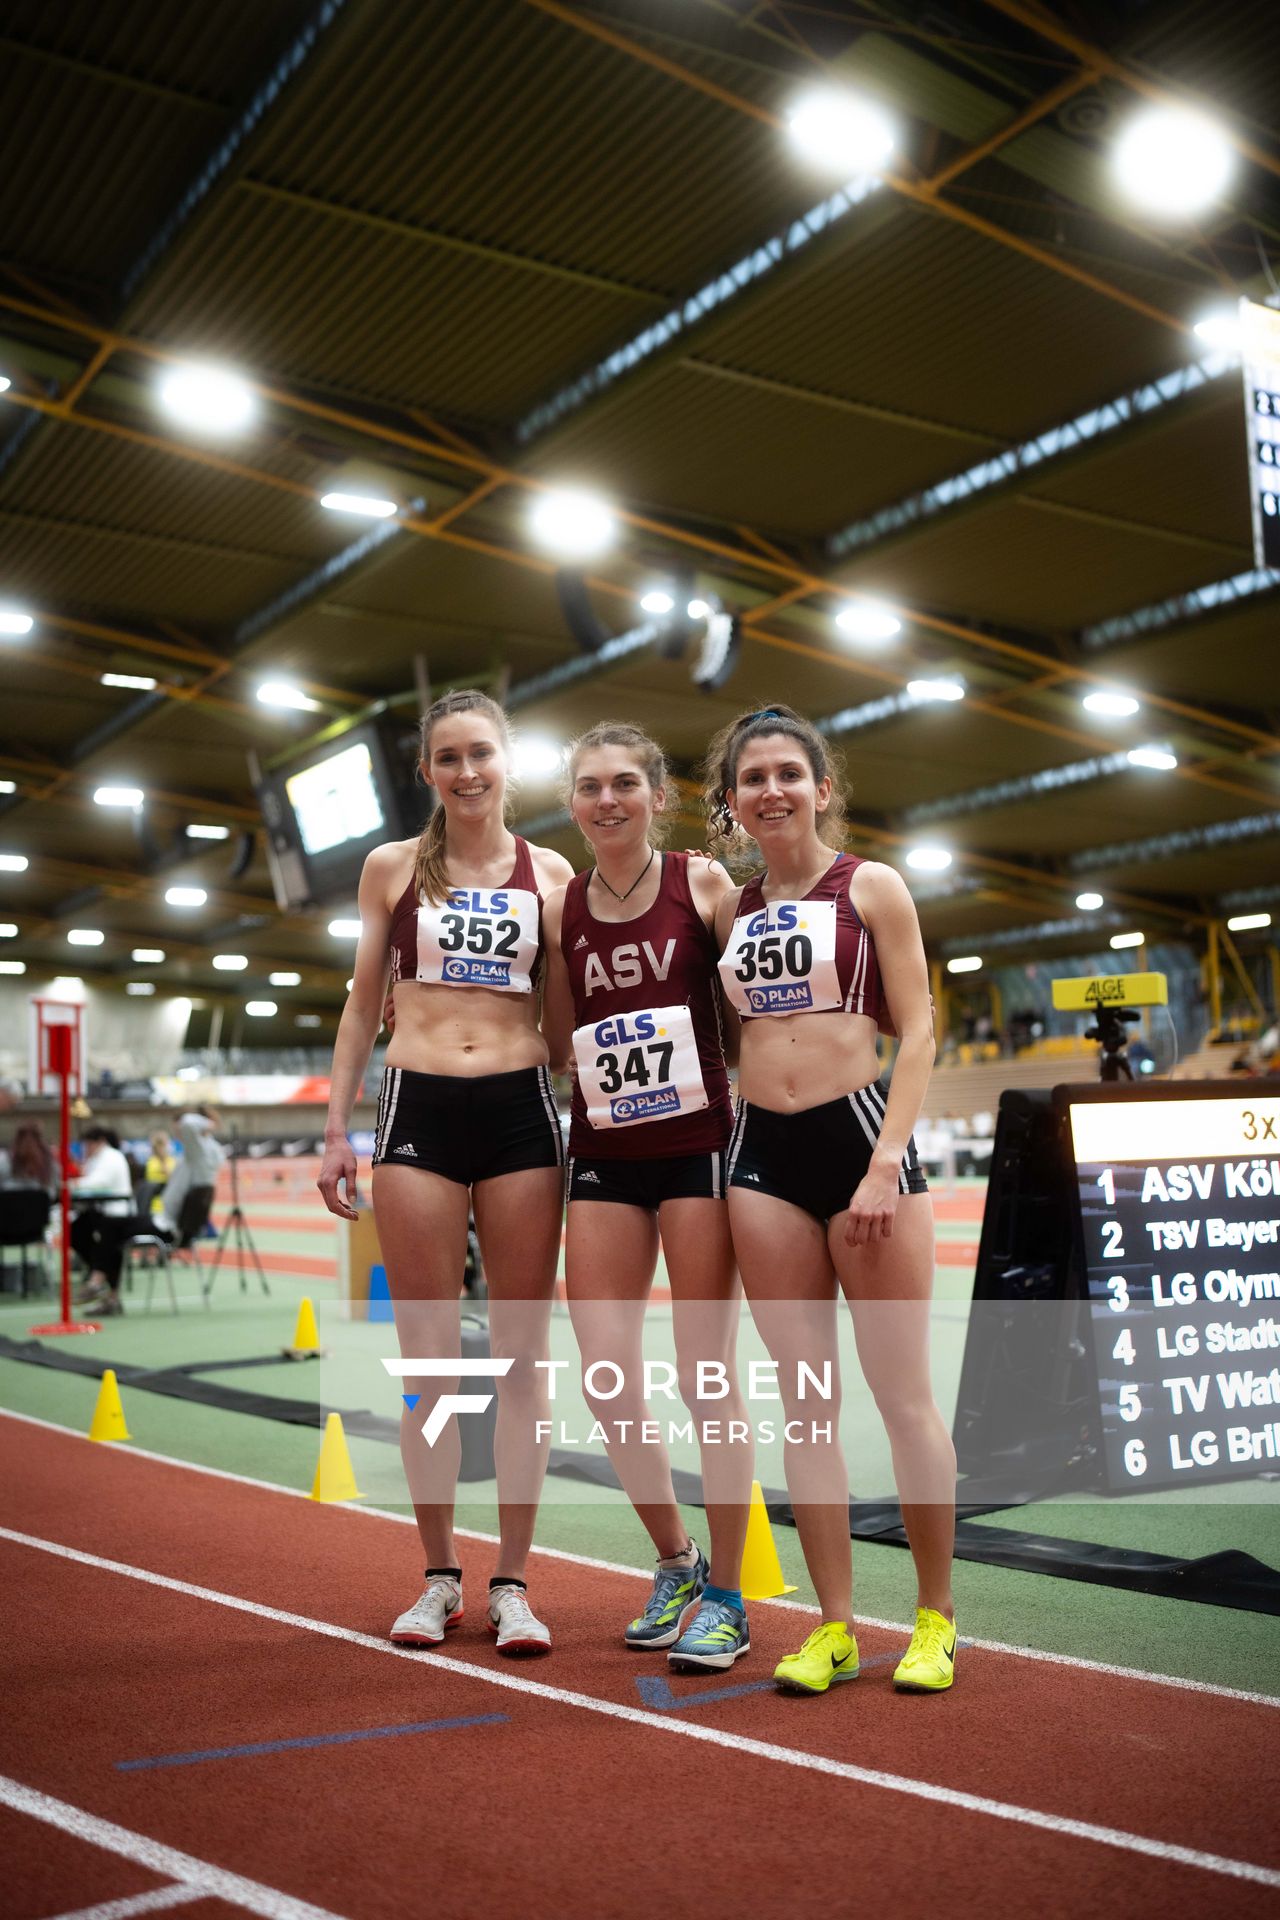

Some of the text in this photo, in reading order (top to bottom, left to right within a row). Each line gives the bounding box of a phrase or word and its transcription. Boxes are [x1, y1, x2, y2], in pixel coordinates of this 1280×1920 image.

[438, 914, 521, 959] 352
[471, 963, 507, 977] PLAN
[585, 938, 677, 997] ASV
[735, 934, 812, 983] 350
[470, 975, 508, 983] INTERNATIONAL
[768, 986, 808, 1002] PLAN
[1085, 979, 1125, 996] ALGE
[770, 999, 810, 1009] INTERNATIONAL
[596, 1041, 674, 1094] 347
[637, 1092, 676, 1109] PLAN
[638, 1103, 678, 1115] INTERNATIONAL
[1097, 1160, 1280, 1205] 1 ASV Köl
[1101, 1218, 1280, 1258] 2 TSV Bayer
[1107, 1276, 1129, 1312] 3
[1151, 1272, 1197, 1307] LG
[1113, 1329, 1136, 1365] 4
[1157, 1325, 1199, 1358] LG
[1119, 1368, 1280, 1421] 5 TV Wat
[1124, 1439, 1147, 1476] 6
[1169, 1431, 1219, 1469] LG
